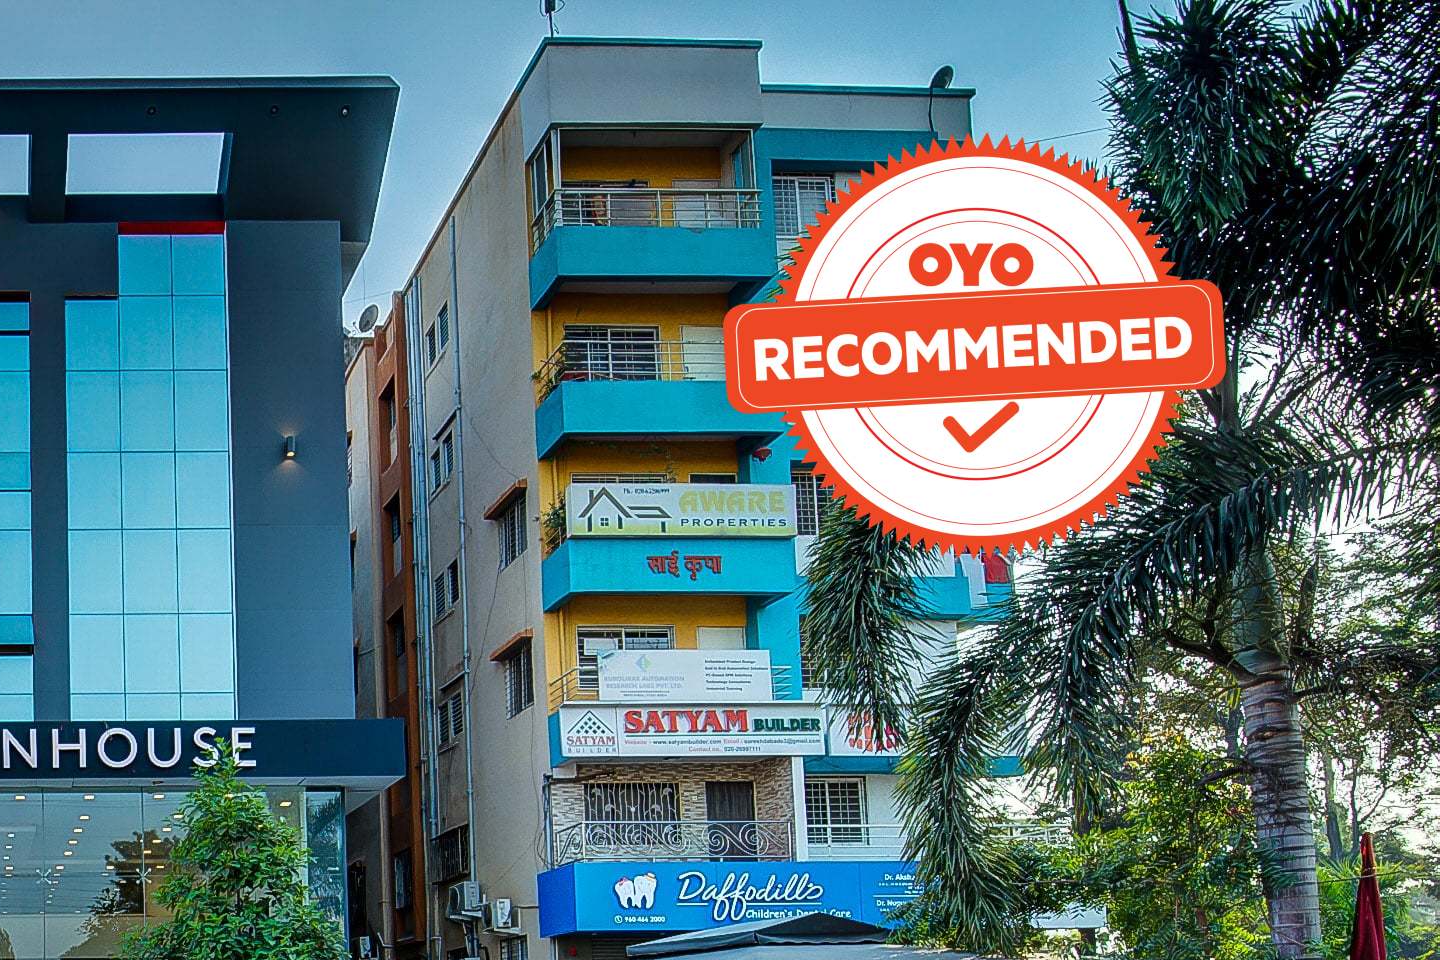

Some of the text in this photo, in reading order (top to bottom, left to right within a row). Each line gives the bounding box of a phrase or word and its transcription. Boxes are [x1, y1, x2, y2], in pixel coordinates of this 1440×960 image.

[678, 490, 785, 513] AWARE
[680, 518, 787, 527] PROPERTIES
[624, 710, 821, 733] SATYAM BUILDER
[566, 735, 616, 745] SATYAM
[745, 908, 793, 919] Children's
[829, 908, 852, 918] Care
